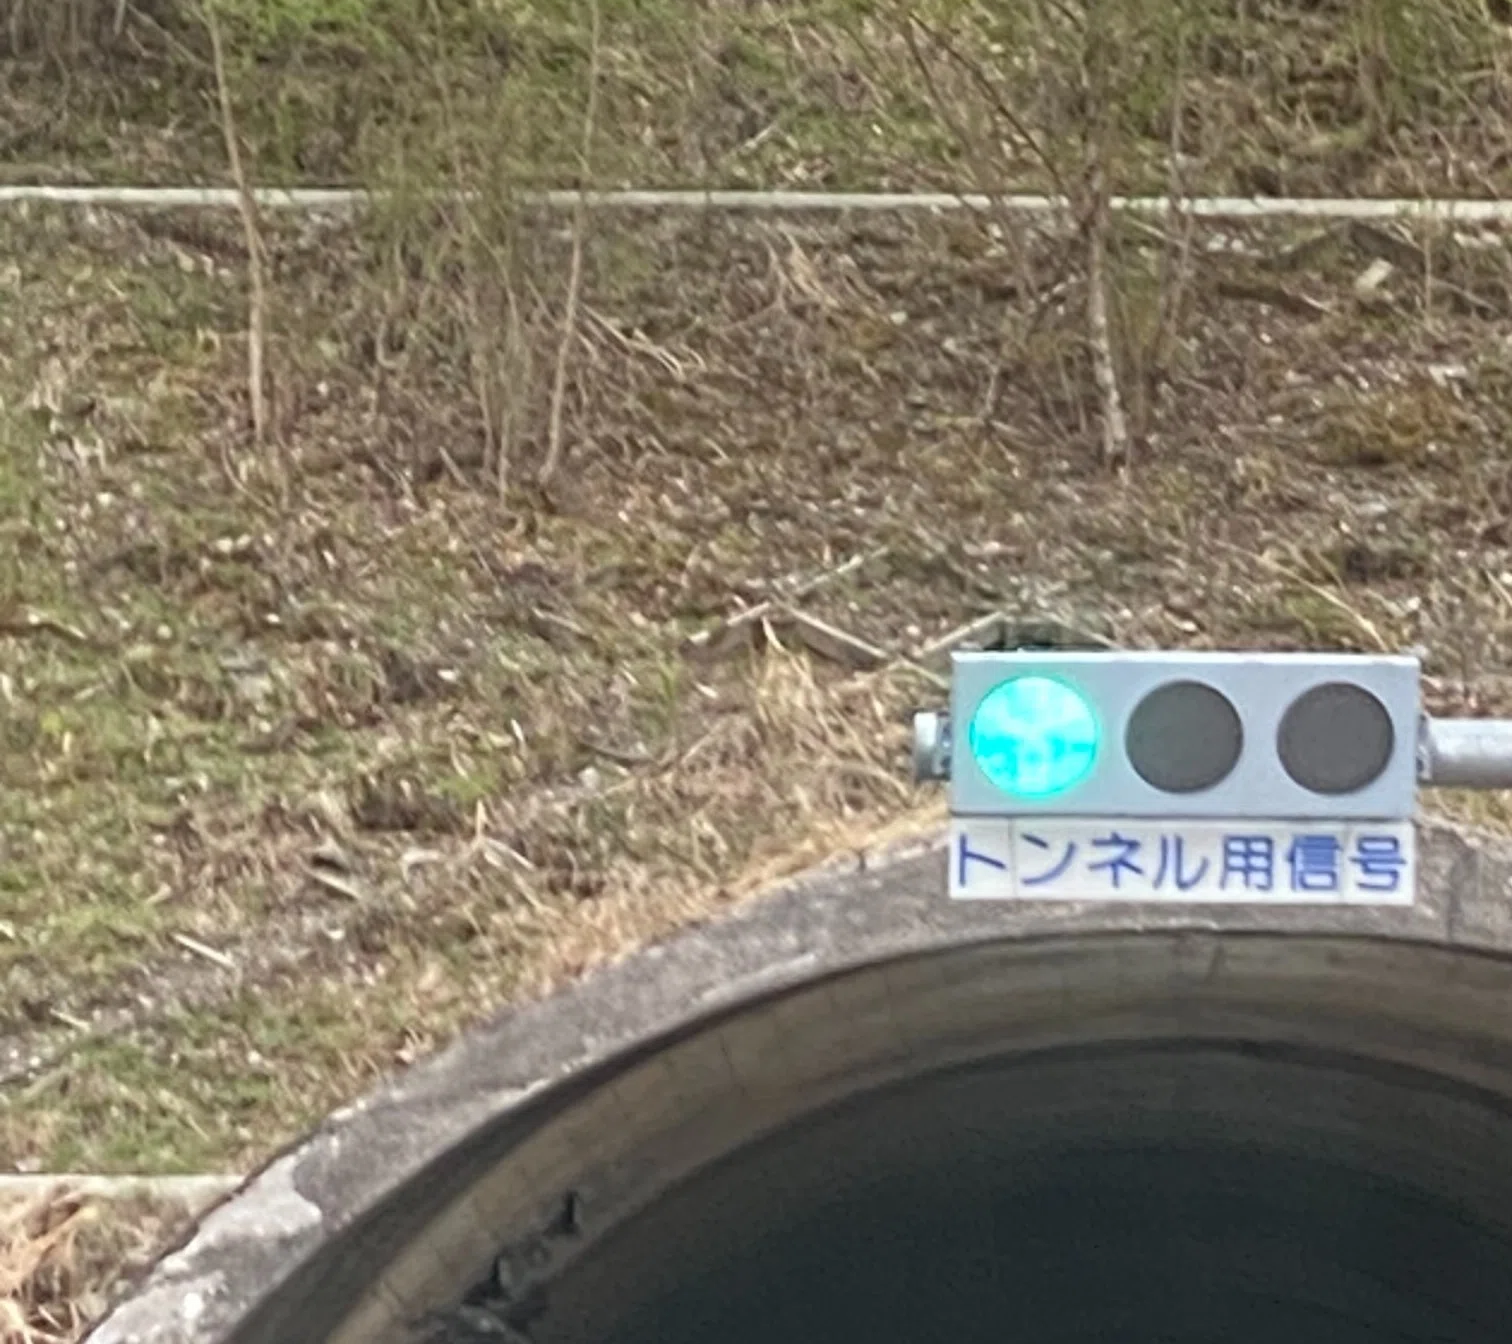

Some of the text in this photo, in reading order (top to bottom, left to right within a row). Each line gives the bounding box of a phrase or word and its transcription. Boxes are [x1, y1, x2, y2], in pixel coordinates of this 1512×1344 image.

[958, 831, 1407, 892] トンネル用信号
